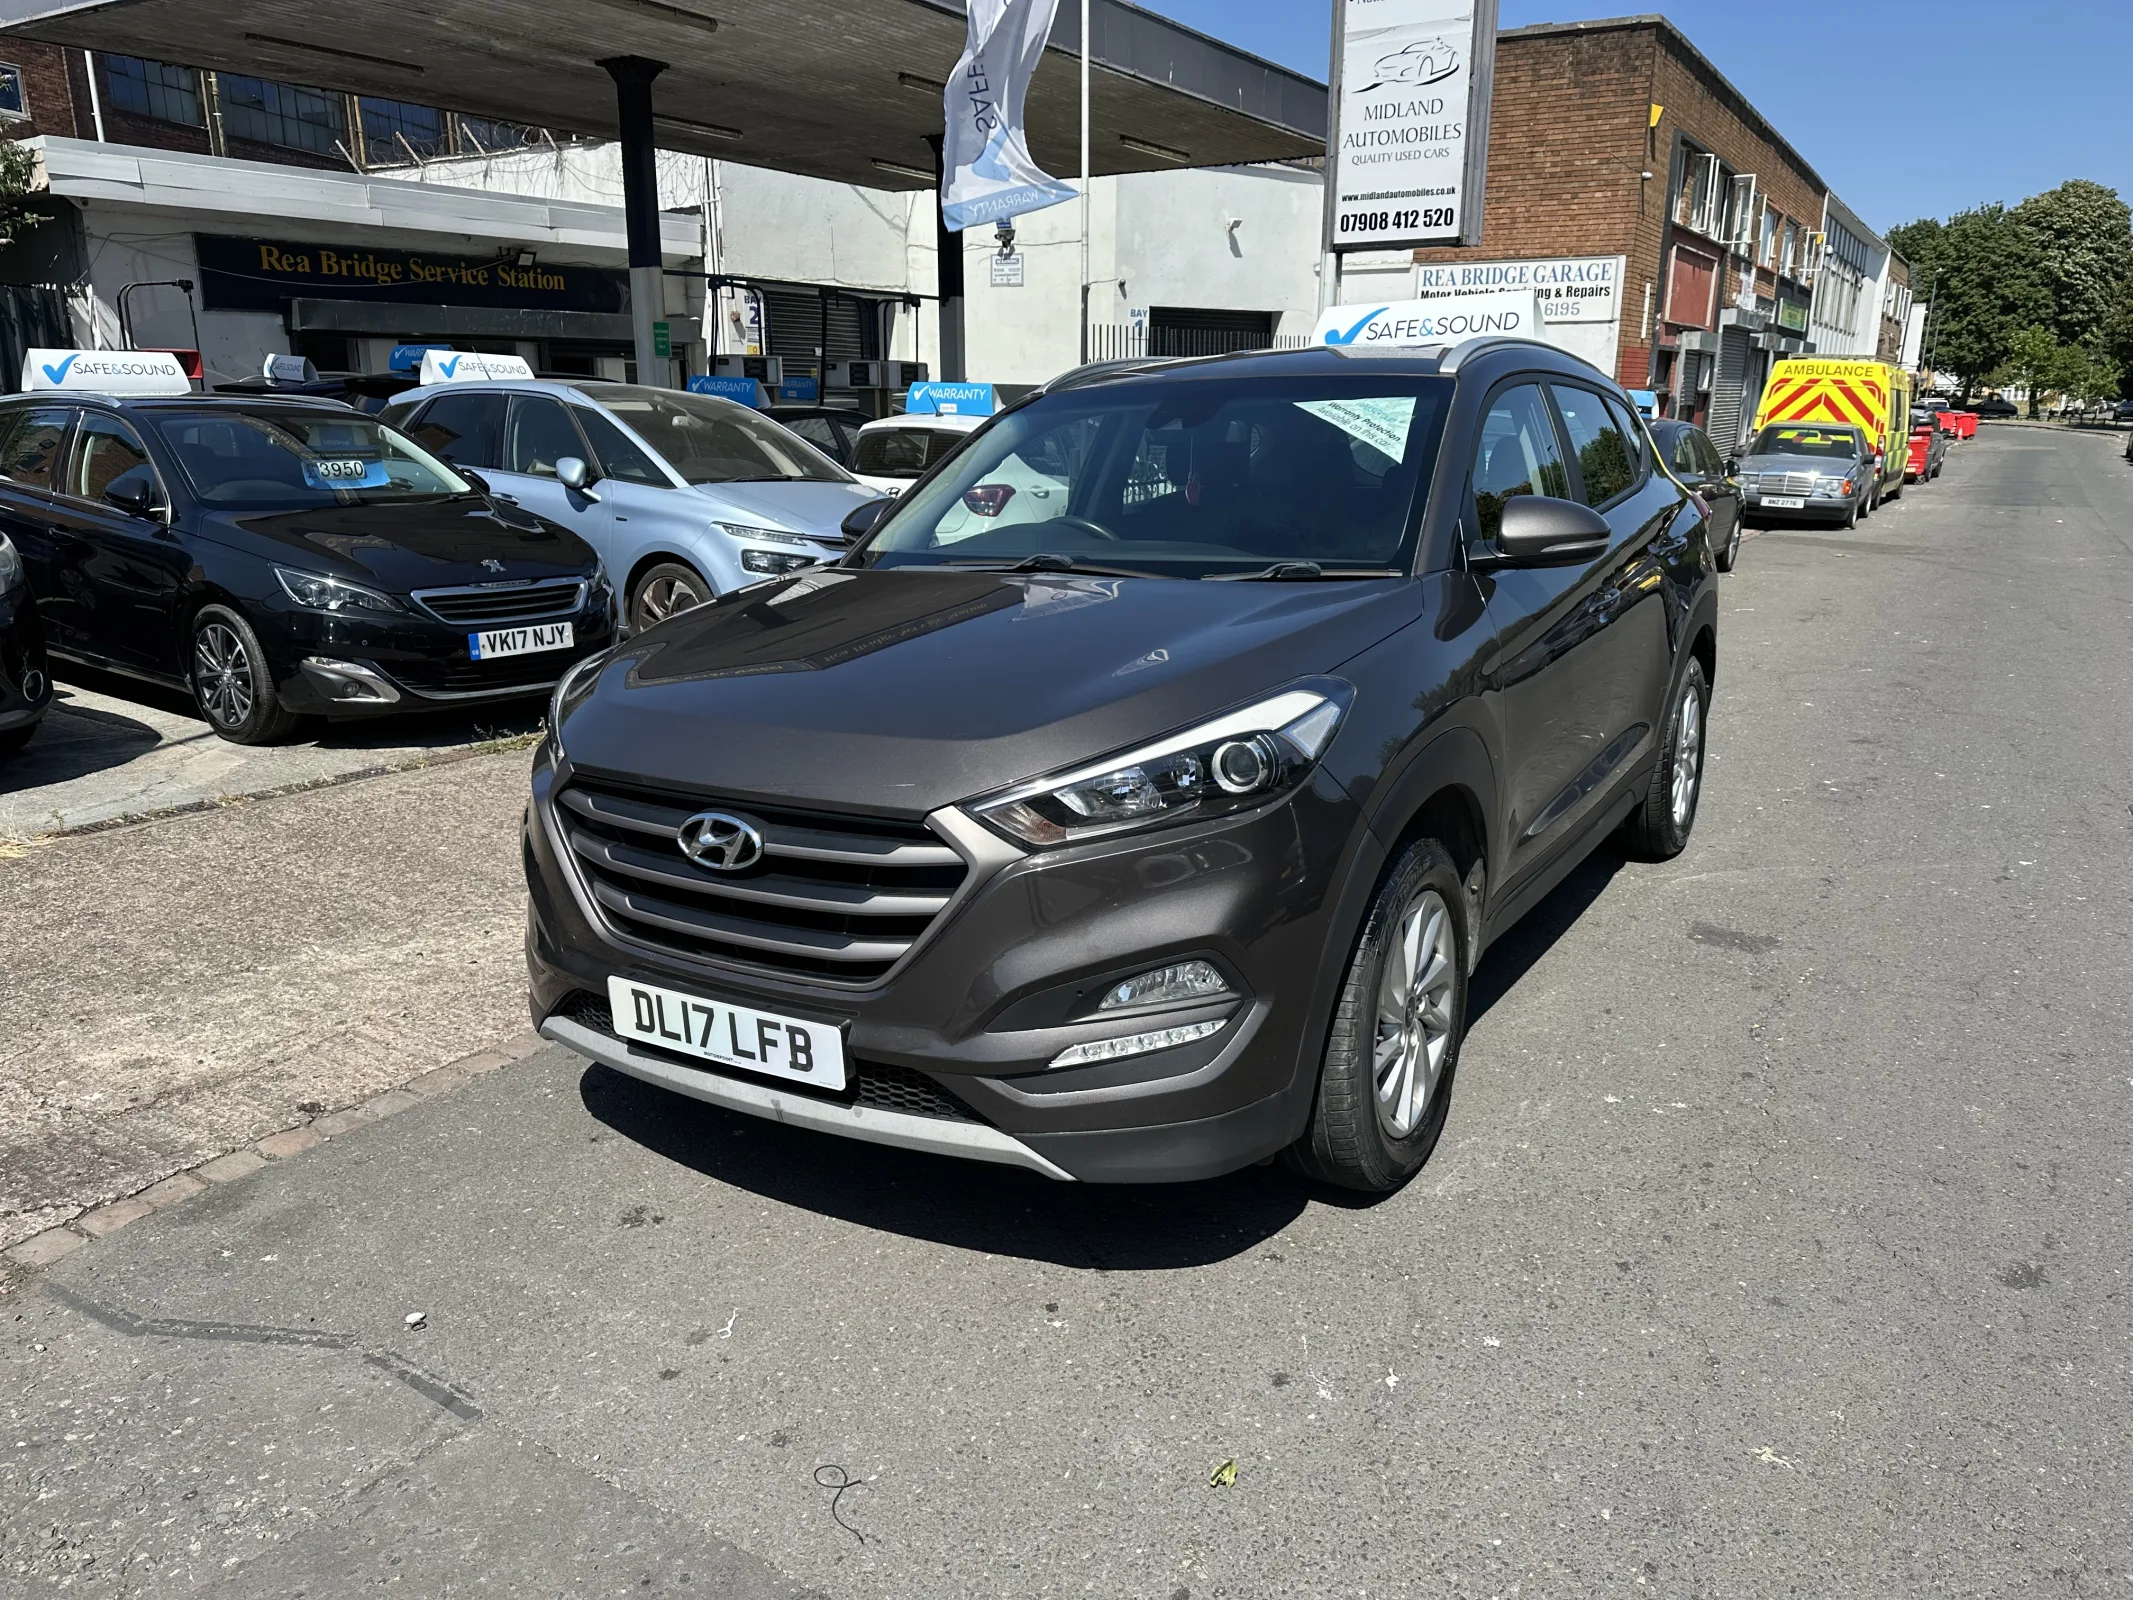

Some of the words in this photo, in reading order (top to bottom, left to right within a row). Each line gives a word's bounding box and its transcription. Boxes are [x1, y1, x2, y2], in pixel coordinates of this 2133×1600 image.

[1364, 98, 1444, 121] MIDLAND
[1343, 123, 1462, 149] AUTOMOBILES
[1351, 152, 1393, 165] QUALITY
[1395, 149, 1421, 161] USED
[1424, 147, 1450, 159] CARS
[1341, 186, 1456, 202] www.midlandautomobiles.co.uk
[1340, 211, 1389, 232] 07908
[1392, 209, 1420, 229] 412
[1423, 207, 1454, 227] 520
[259, 245, 311, 273] Rea
[320, 250, 403, 285] Bridge
[409, 257, 490, 286] Service
[498, 264, 566, 291] Station
[1422, 268, 1457, 287] REA
[1461, 265, 1529, 286] BRIDGE
[1533, 263, 1612, 283] GARAGE
[1555, 288, 1562, 298] &
[1566, 285, 1611, 299] Repairs
[749, 306, 760, 324] 2
[1130, 309, 1148, 317] BAY
[1134, 319, 1143, 337] 1
[1366, 311, 1520, 341] SAFE&SOUND
[73, 362, 176, 376] SAFE&SOUND
[458, 361, 527, 375] SAFE&SOUND
[1784, 364, 1875, 377] AMBULANCE
[704, 381, 752, 393] WARRANTY
[929, 387, 987, 400] WARRANTY
[1316, 406, 1350, 426] Available
[1361, 429, 1377, 440] this
[1328, 401, 1361, 420] Warranty
[1361, 418, 1401, 442] Protection
[486, 630, 527, 653] VK17
[533, 625, 565, 647] NJY
[631, 988, 714, 1049] DL17
[728, 1011, 813, 1073] LFB
